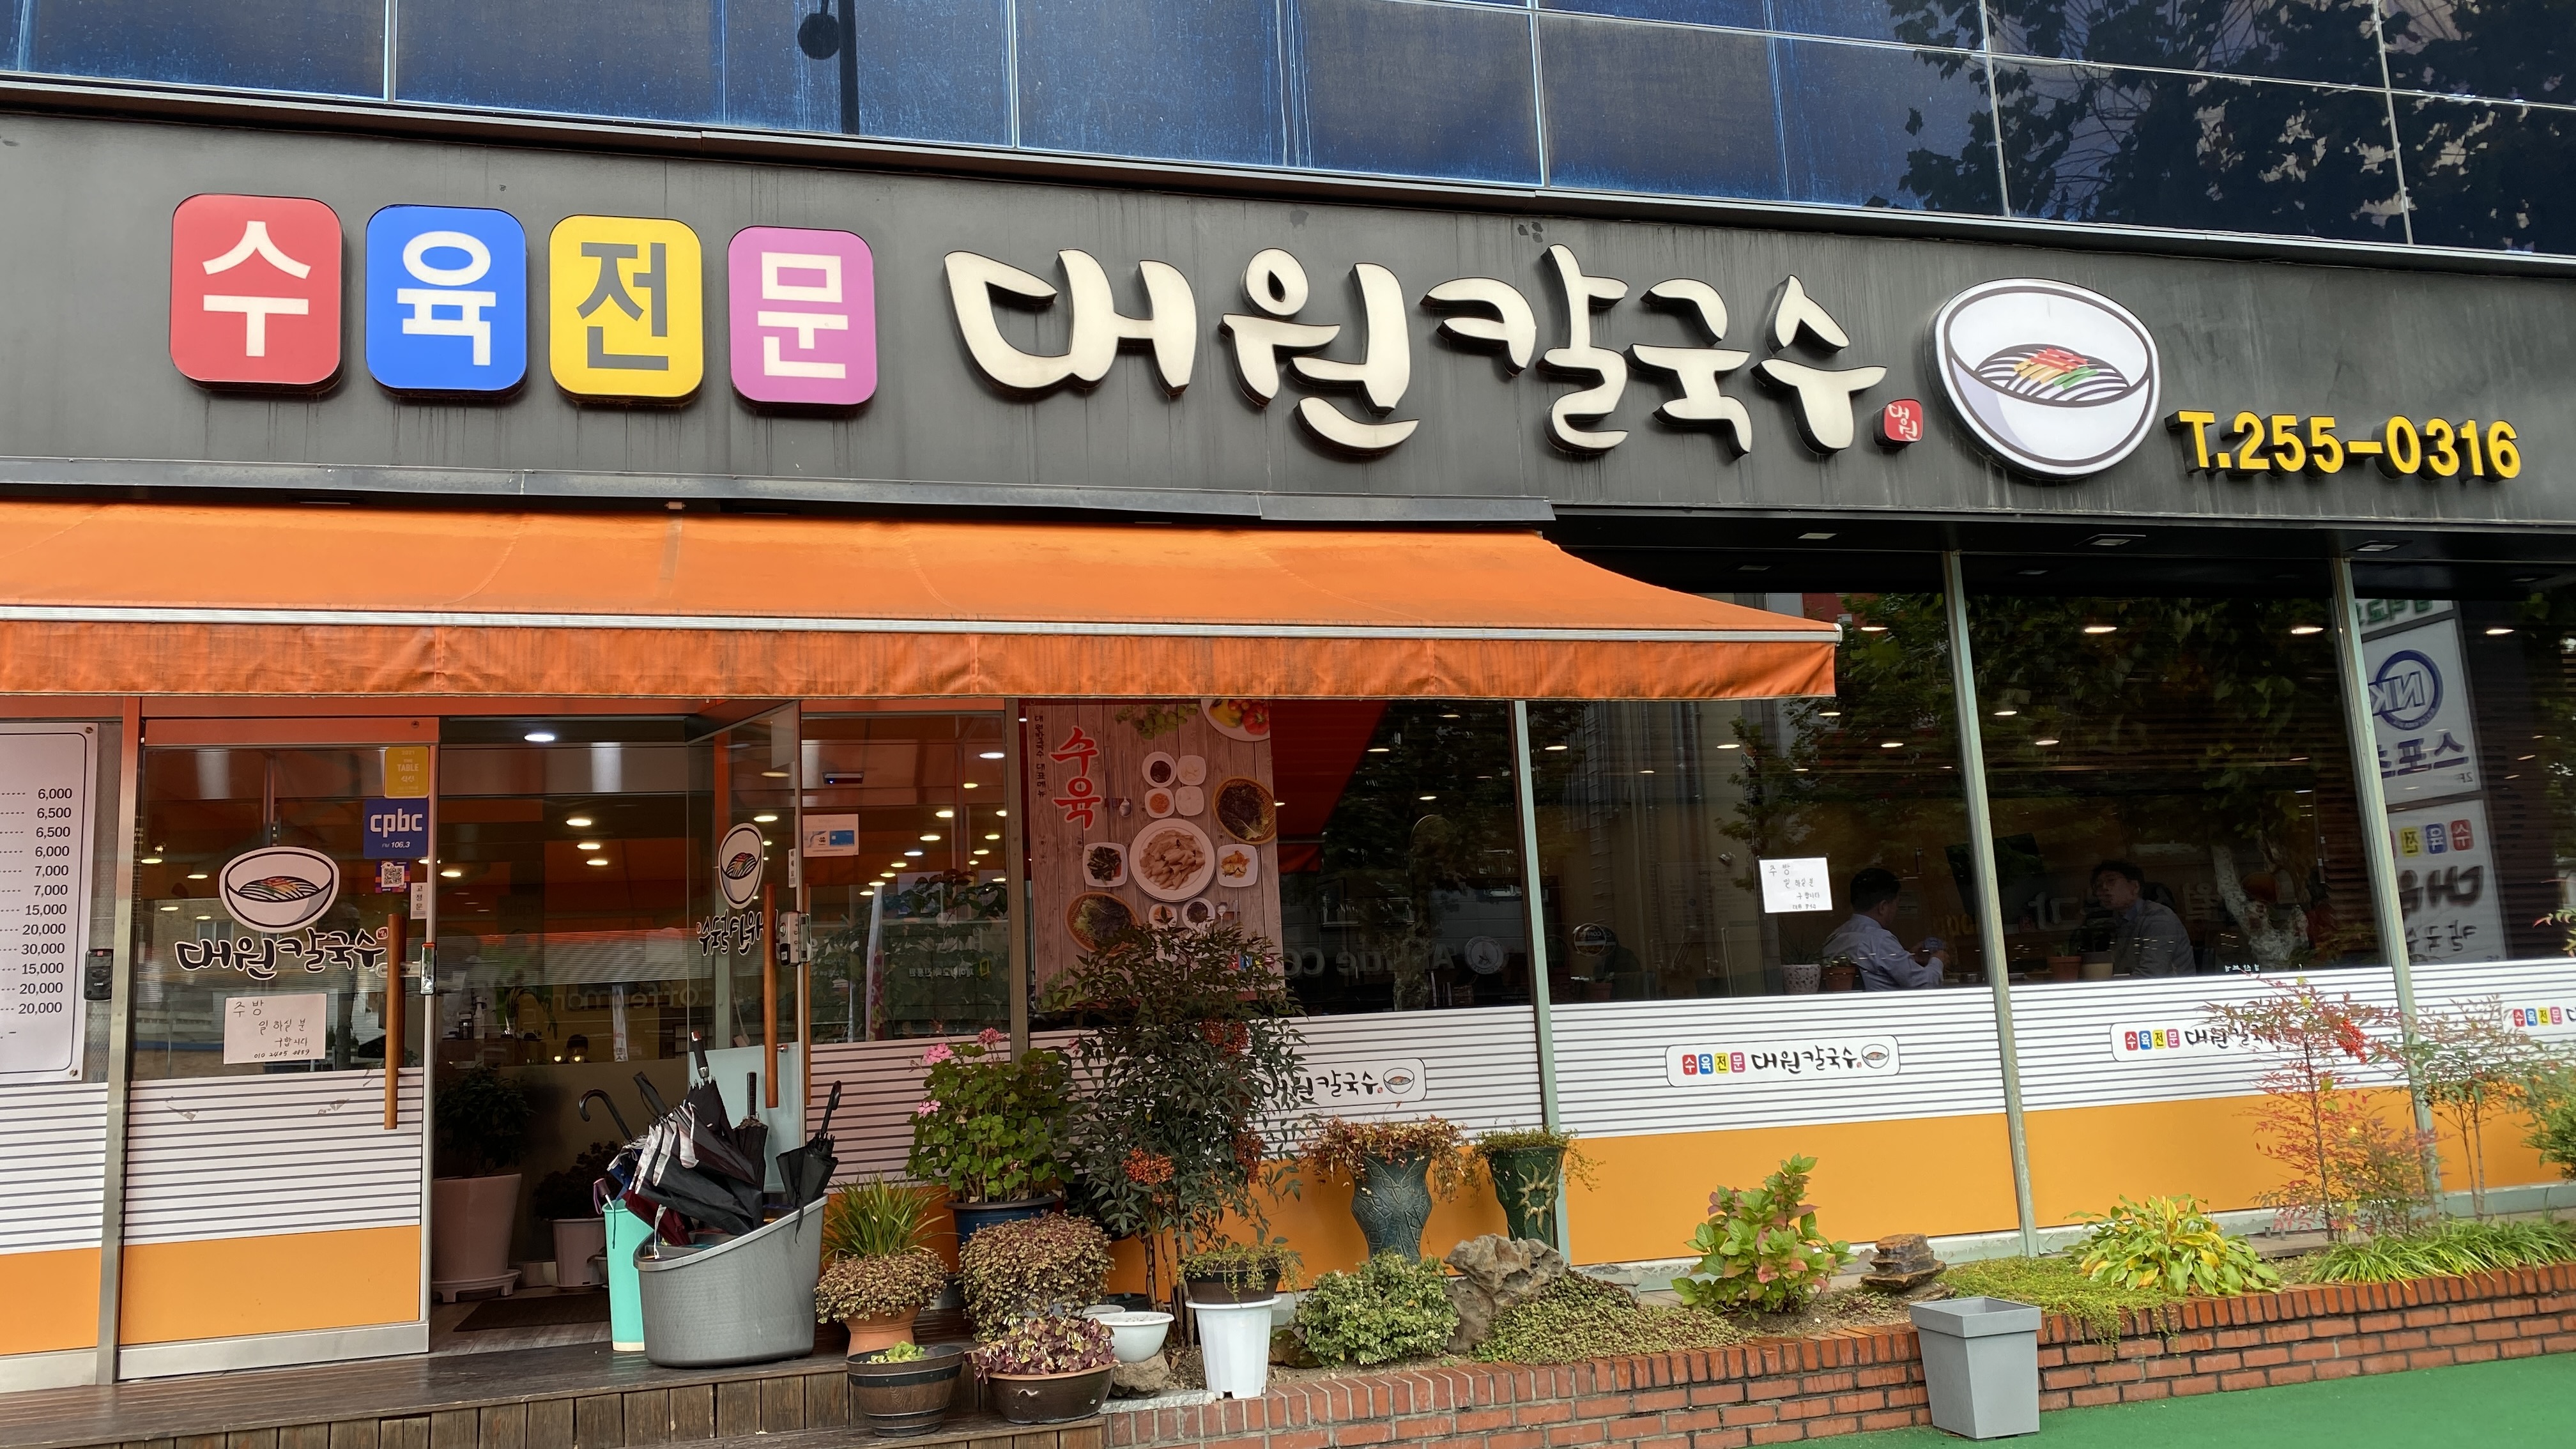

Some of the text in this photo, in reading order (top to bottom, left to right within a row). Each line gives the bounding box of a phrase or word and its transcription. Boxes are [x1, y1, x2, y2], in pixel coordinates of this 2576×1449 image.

[203, 220, 1918, 456] 수육전문 대원칼국수 대원
[2179, 410, 2521, 479] T.255-0316
[397, 763, 419, 772] TABLE
[1036, 763, 1046, 798] 대표메뉴
[1050, 726, 1101, 829] 수육
[38, 788, 72, 801] 6,000
[37, 807, 72, 820] 6,500
[370, 808, 423, 838] cpbc
[36, 826, 70, 839] 6,500
[35, 845, 70, 859] 6,000
[34, 865, 69, 878] 7,000
[1769, 864, 1791, 877] 주방
[34, 884, 68, 898] 7,000
[25, 903, 67, 917] 15,000
[22, 923, 66, 937] 20,000
[21, 942, 65, 956] 30,000
[175, 927, 386, 979] 대원칼국수
[22, 962, 64, 976] 15,000
[19, 982, 63, 995] 20,000
[19, 1002, 62, 1015] 20,000
[233, 999, 264, 1017] 주방
[2514, 1009, 2561, 1025] 수육전문
[258, 1018, 305, 1035] 일 하실 분
[2126, 1031, 2179, 1050] 수육전문
[1683, 1045, 1857, 1074] 수육전문 대원칼국수
